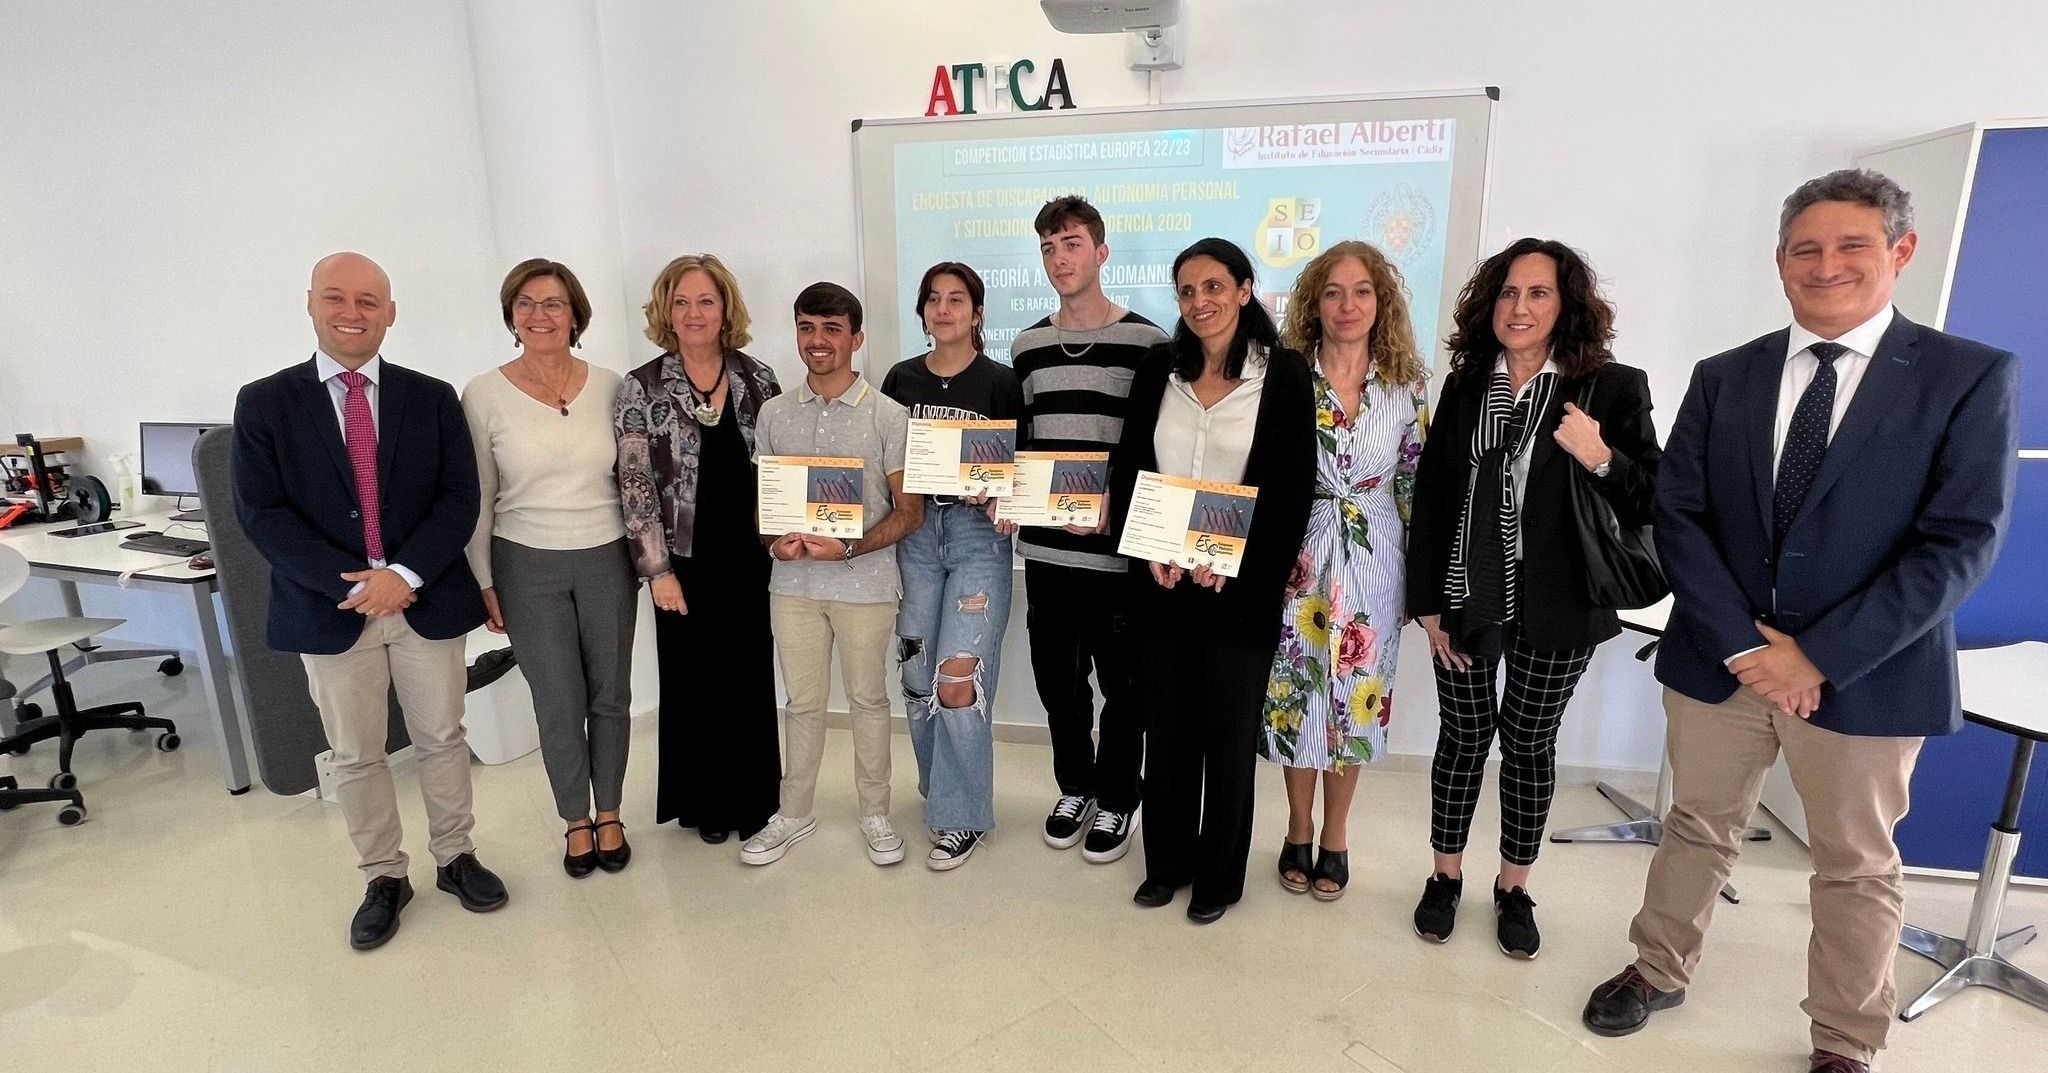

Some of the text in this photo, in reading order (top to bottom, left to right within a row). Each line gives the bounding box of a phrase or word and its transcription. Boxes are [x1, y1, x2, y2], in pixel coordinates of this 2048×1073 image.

[925, 58, 1077, 117] ATECA
[1258, 119, 1445, 148] Rafael Alberti
[955, 138, 1191, 165] COMPETICIÓN ESTADÍSTICA EUROPEA 22/23
[1298, 150, 1308, 159] de
[912, 190, 974, 211] ENCUESTA
[980, 190, 992, 209] DE
[1173, 181, 1240, 201] PERSONAL
[953, 220, 961, 239] Y
[1158, 213, 1191, 231] 2020
[1010, 297, 1025, 312] IES
